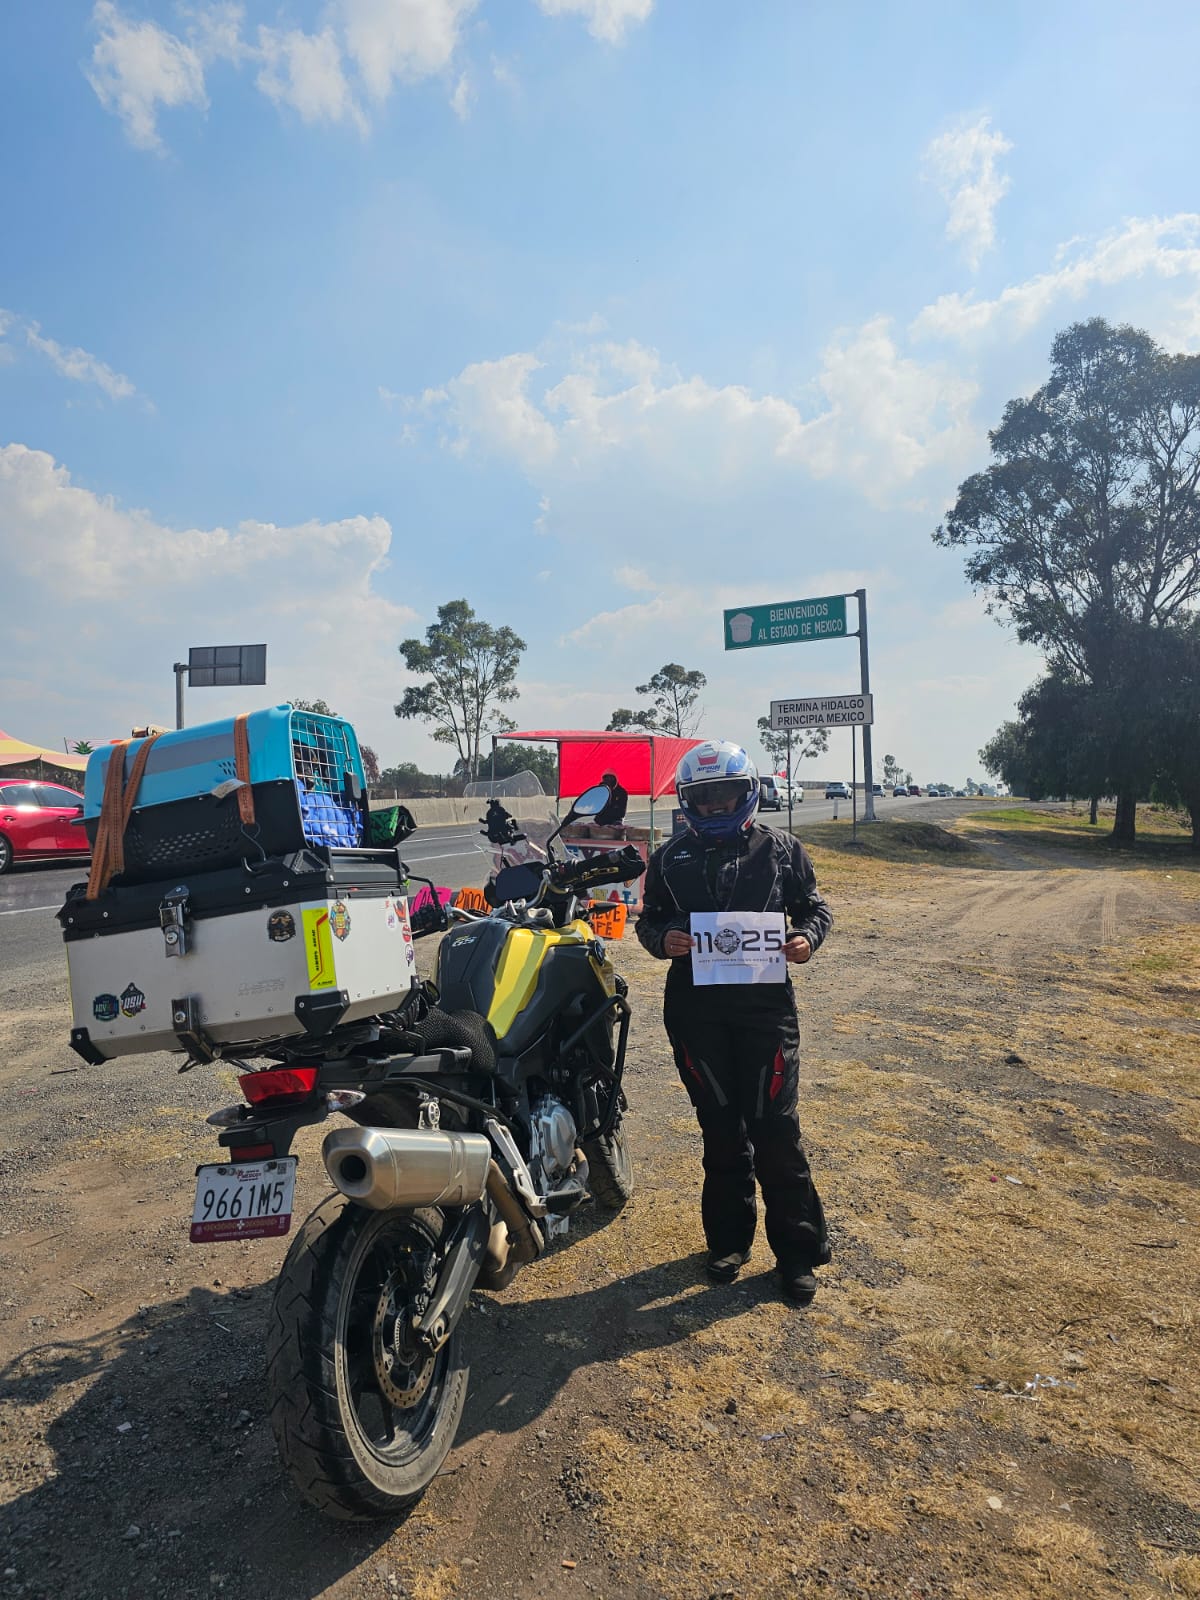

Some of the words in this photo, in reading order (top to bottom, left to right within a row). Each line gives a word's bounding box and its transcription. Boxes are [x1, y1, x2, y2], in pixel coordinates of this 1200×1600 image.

[769, 603, 829, 622] BIENVENIDOS
[758, 627, 768, 641] AL
[770, 624, 799, 639] ESTADO
[801, 623, 812, 636] DE
[814, 618, 843, 634] MEXICO
[778, 701, 819, 714] TERMINA
[821, 698, 864, 711] HIDALGO
[777, 714, 825, 726] PRINCIPIA
[826, 711, 865, 723] MEXICO
[202, 1181, 285, 1221] 9661M5
